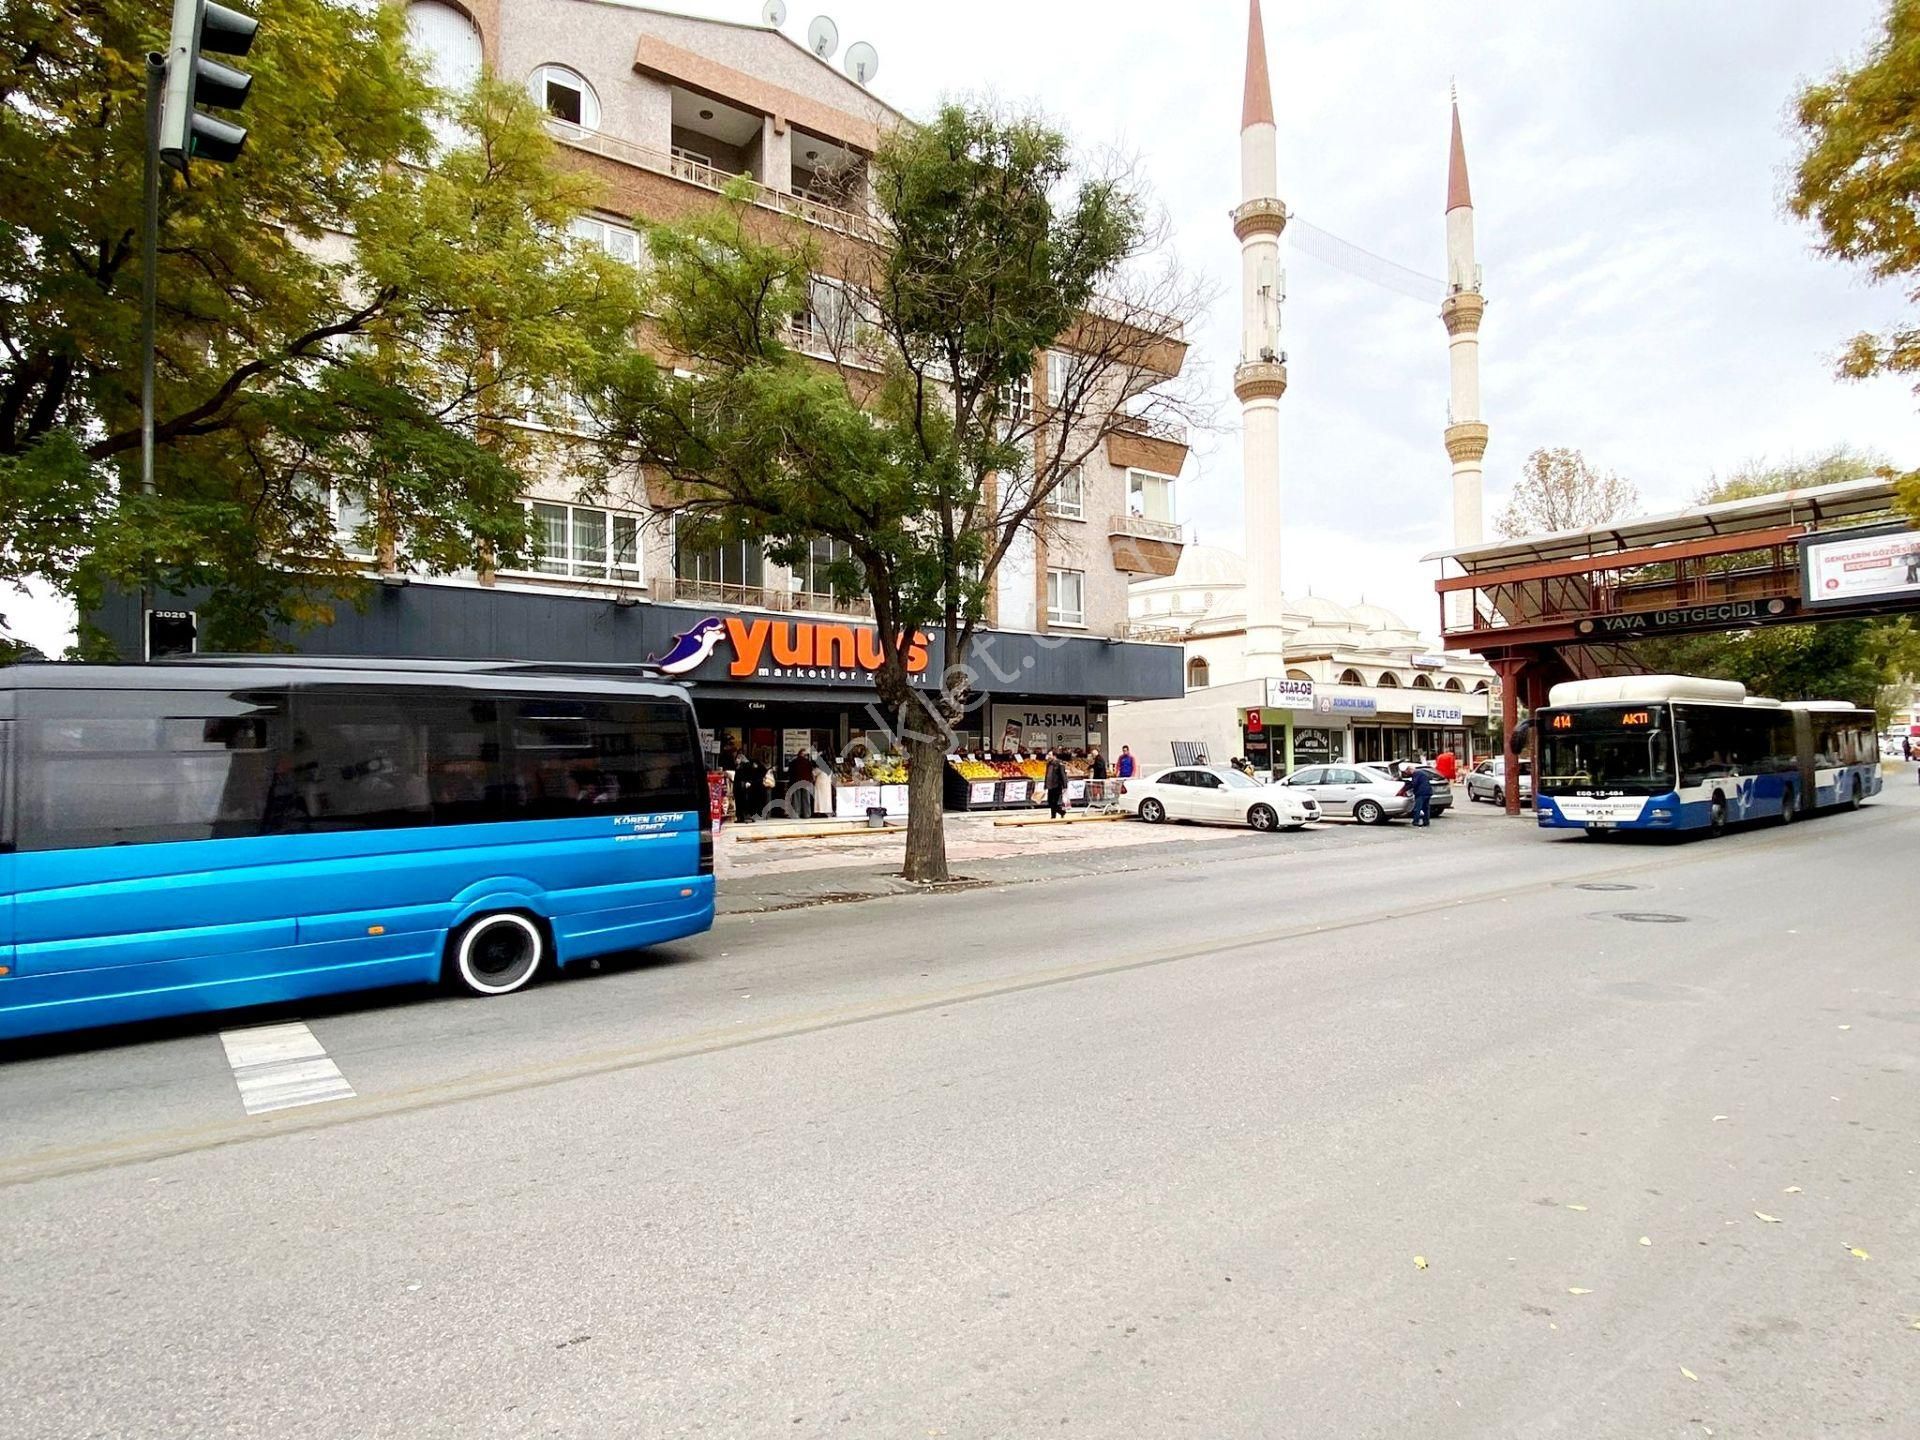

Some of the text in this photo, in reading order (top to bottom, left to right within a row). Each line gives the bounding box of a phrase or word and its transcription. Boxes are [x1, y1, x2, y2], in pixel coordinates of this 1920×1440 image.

[1604, 601, 1756, 631] YAYA ÜSTGEÇİDİ
[726, 617, 929, 676] yunus
[758, 667, 857, 680] marketler
[1416, 708, 1426, 718] EV
[1553, 715, 1571, 728] 414
